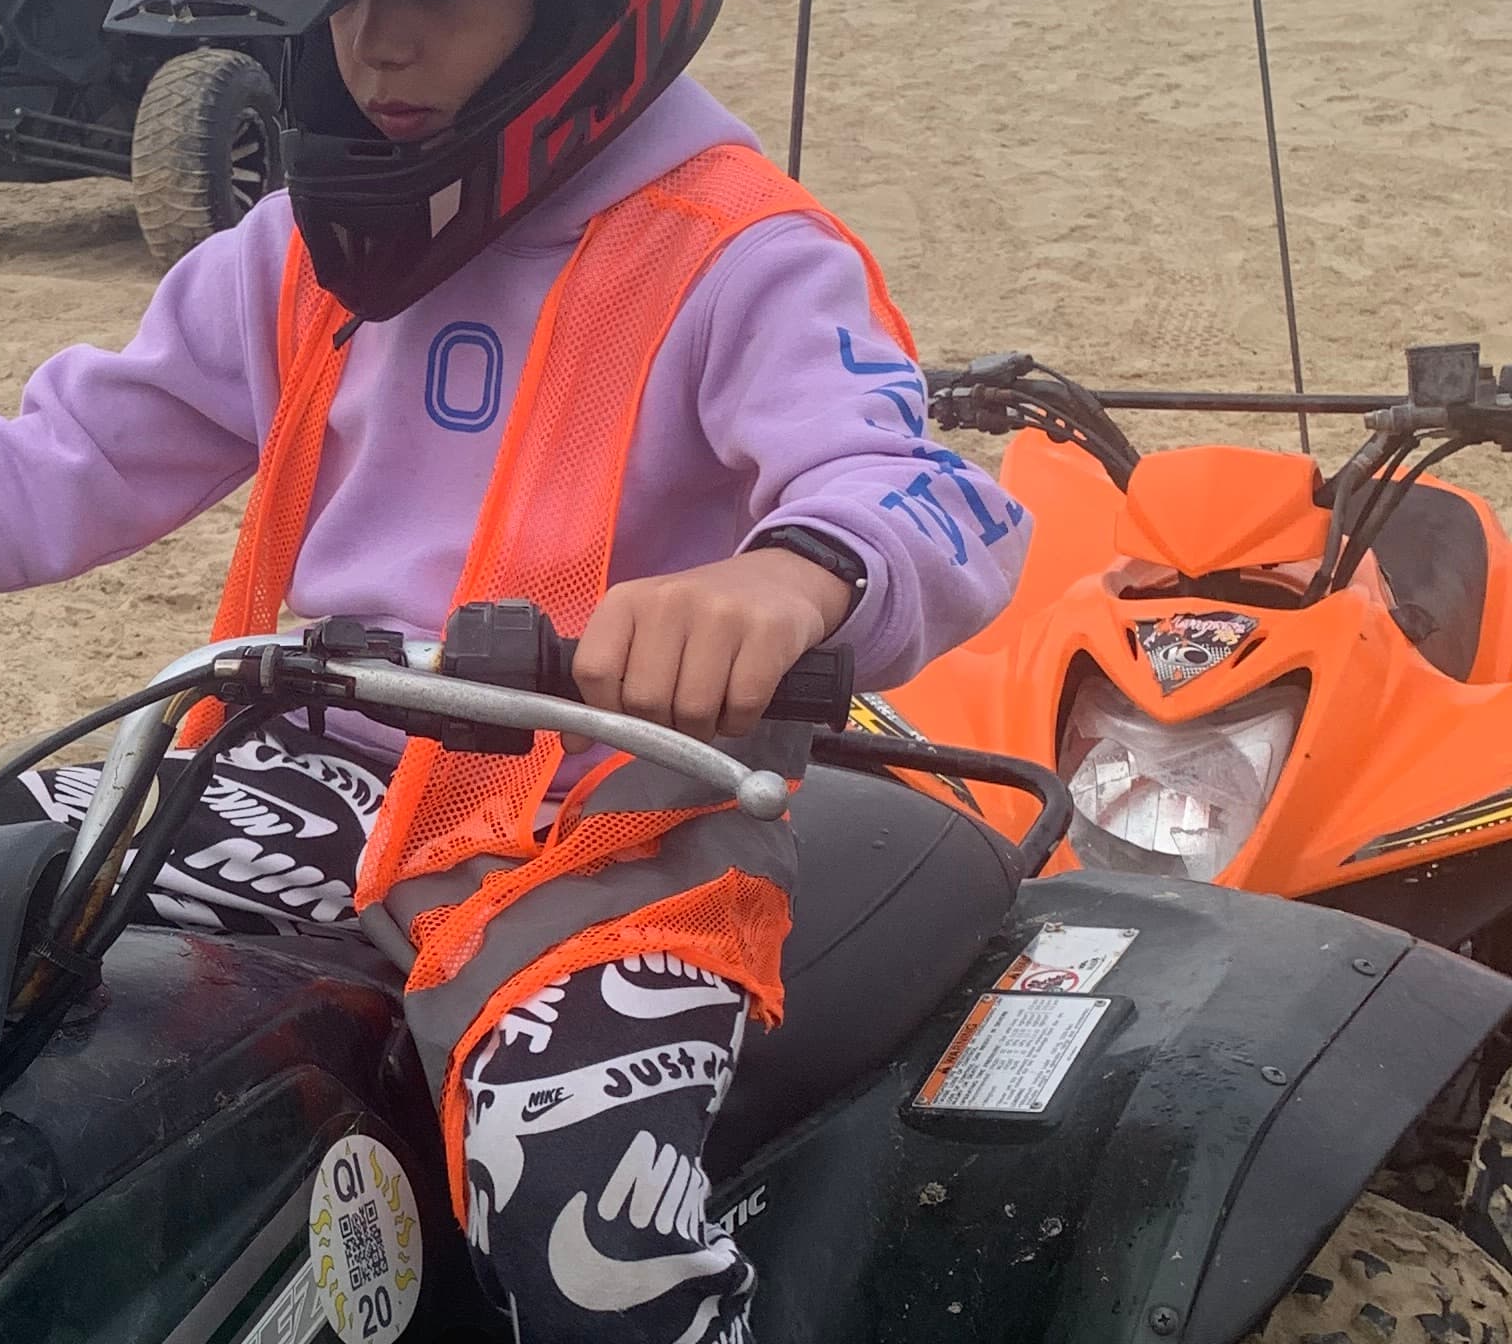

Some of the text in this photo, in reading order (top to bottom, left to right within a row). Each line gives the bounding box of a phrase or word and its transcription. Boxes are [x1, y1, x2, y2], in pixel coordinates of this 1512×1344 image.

[184, 837, 358, 922] NIK
[941, 1022, 979, 1064] WARNING
[528, 1086, 565, 1108] NIKE
[333, 1152, 364, 1203] QI
[358, 1285, 392, 1339] 20
